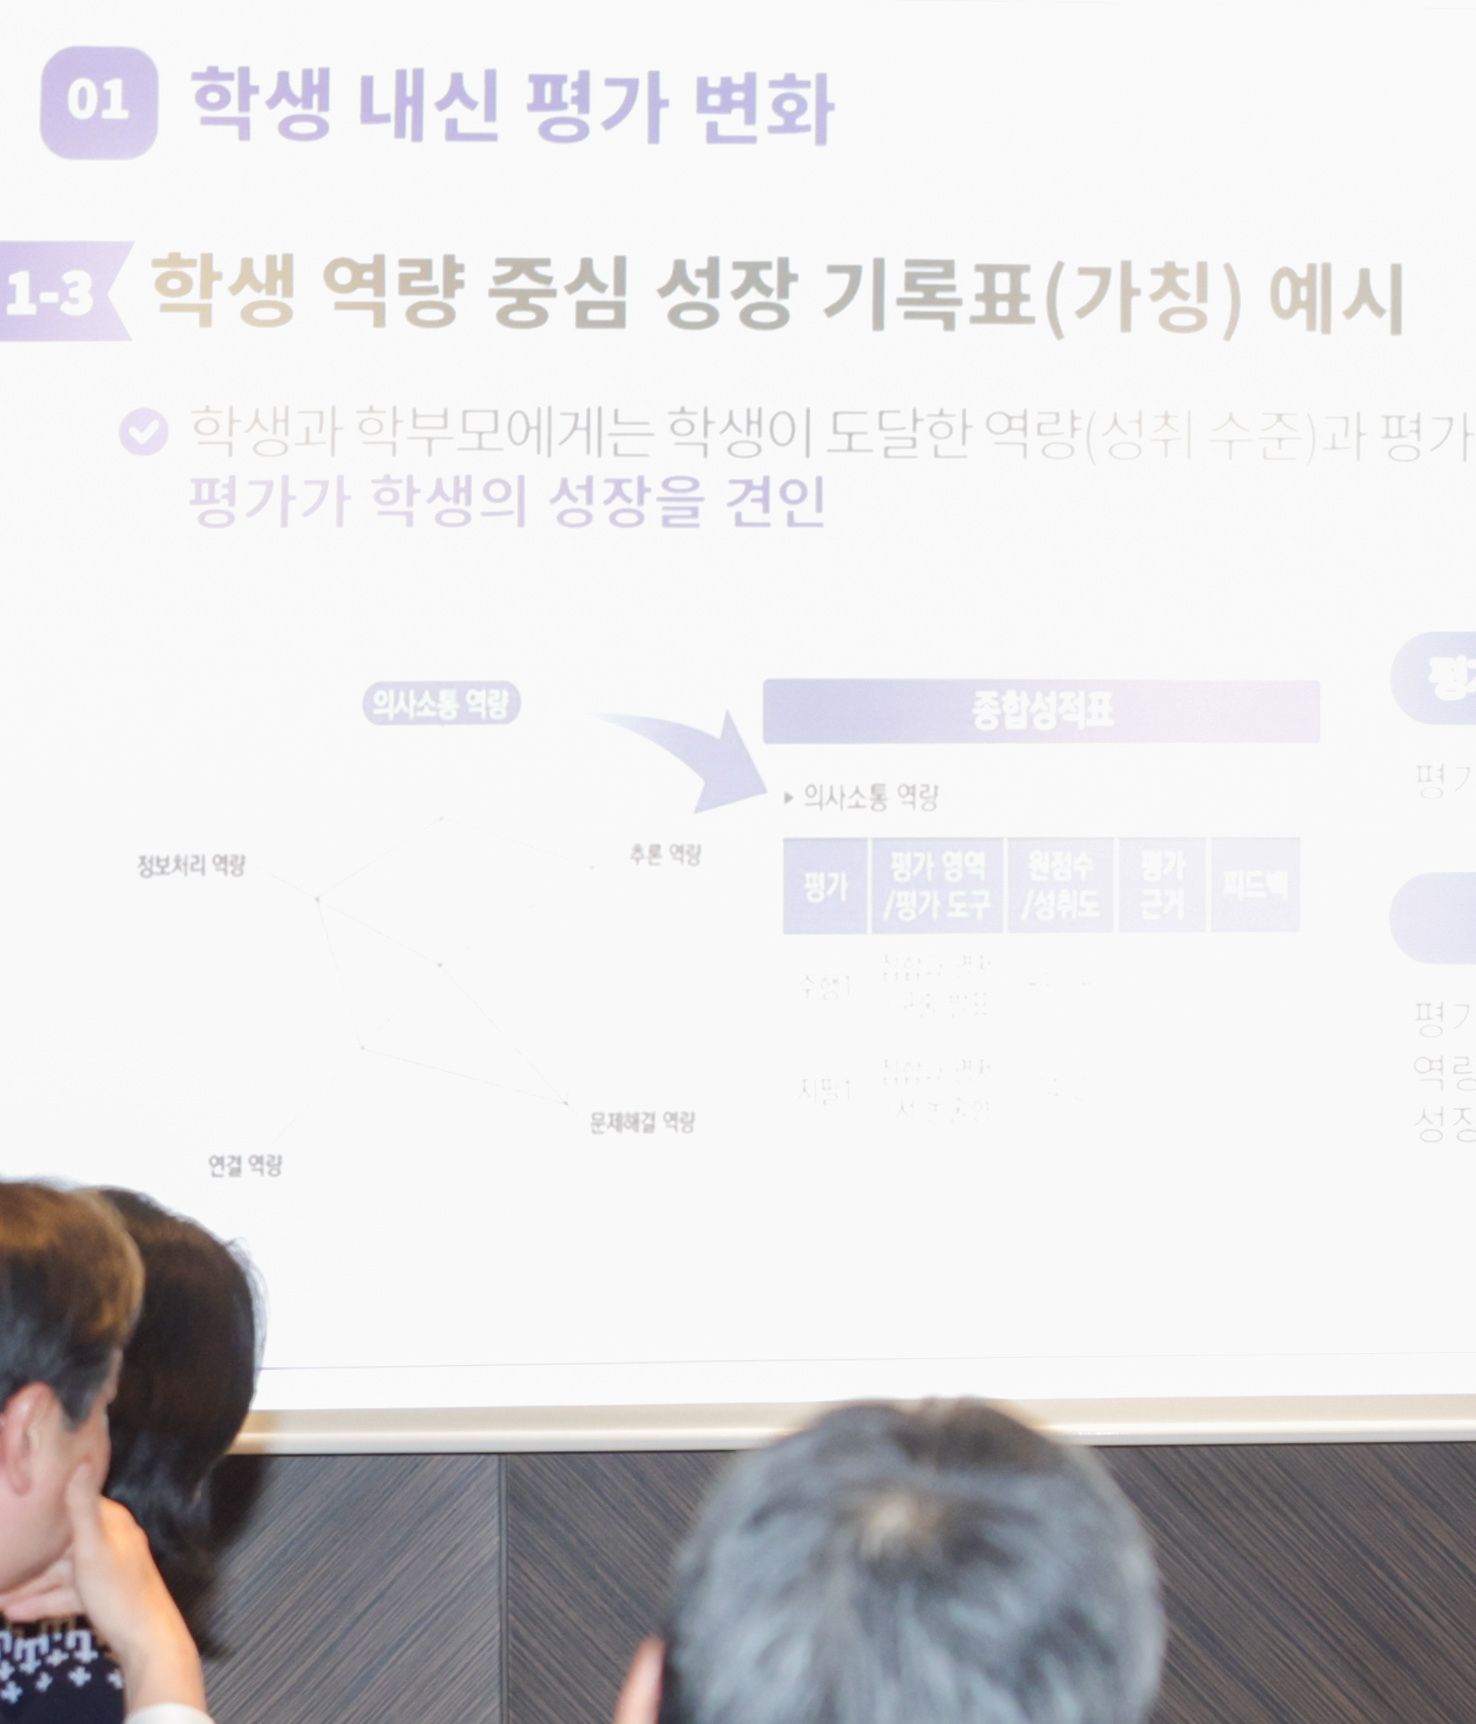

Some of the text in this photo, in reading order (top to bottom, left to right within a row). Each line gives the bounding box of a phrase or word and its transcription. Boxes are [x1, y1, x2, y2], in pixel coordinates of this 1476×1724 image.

[68, 78, 129, 119] 01
[191, 66, 835, 146] 학생 내신 평가 변화
[7, 270, 93, 316] 1-3
[151, 252, 1402, 341] 학생 역량 중심 성장 기록표(가칭) 예시
[191, 405, 343, 459] 학생과
[355, 405, 655, 459] 학부모에게는
[666, 405, 812, 459] 학생이
[827, 407, 973, 459] 도달한
[986, 408, 1191, 465] 역량(성취
[1210, 411, 1367, 465] 수준)과
[1381, 412, 1474, 462] 평가
[189, 474, 824, 528] 평가가 학생의 성장을 견인
[373, 689, 509, 720] 의사소통 역량
[973, 690, 1115, 731] 종합성적표
[805, 783, 939, 812] 의사소통 역량
[138, 854, 246, 879] 정보처리 역량
[631, 844, 701, 866] 추론 역량
[892, 851, 985, 882] 평가 영역
[1141, 850, 1186, 882] 평가
[805, 872, 848, 902] 평가
[884, 890, 991, 921] /평가 도구
[1141, 888, 1184, 920] 근거
[591, 1111, 695, 1134] 문제해결 역량
[209, 1154, 282, 1177] 연결 역량
